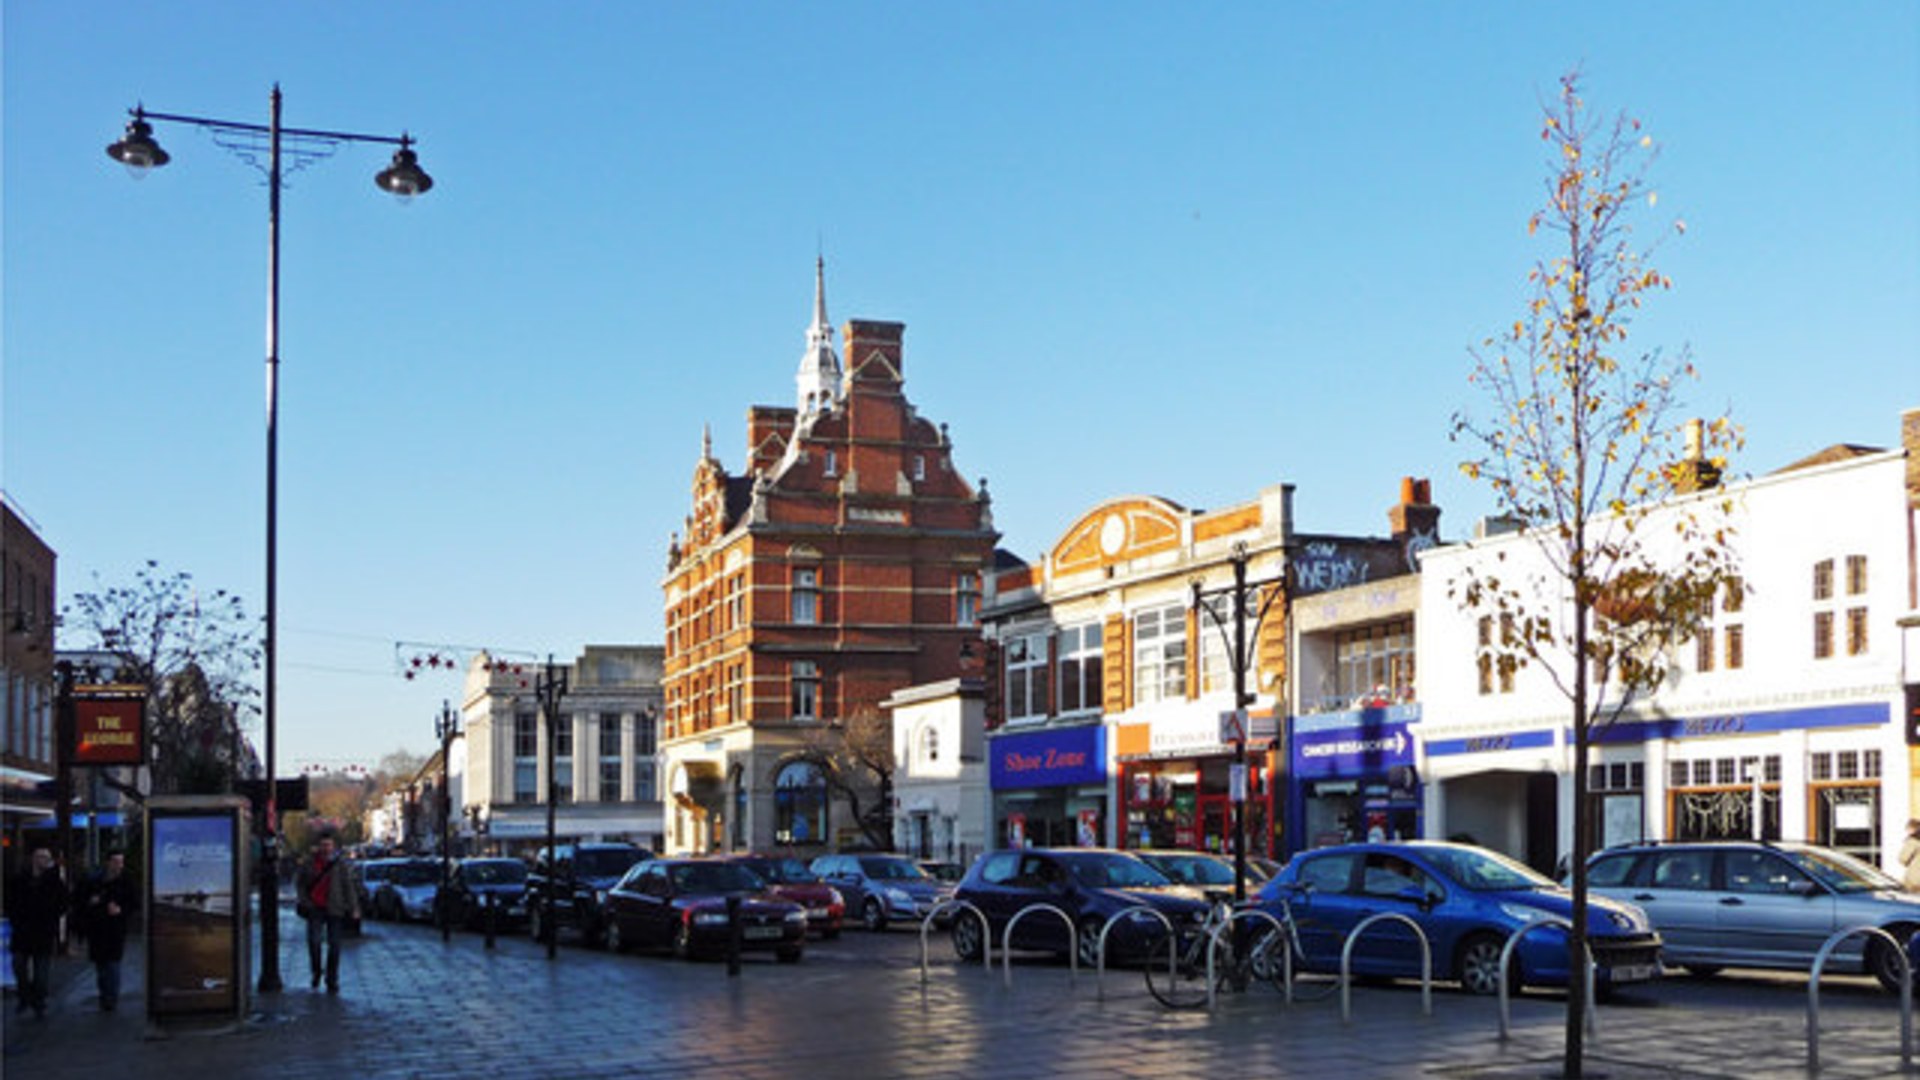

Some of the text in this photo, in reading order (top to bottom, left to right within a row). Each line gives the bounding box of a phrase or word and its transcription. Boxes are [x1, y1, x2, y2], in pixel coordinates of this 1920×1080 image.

[97, 716, 121, 730] THE
[1302, 744, 1336, 758] CANCER
[1337, 740, 1383, 755] RESEARCH
[1005, 747, 1086, 772] Shoe Zone
